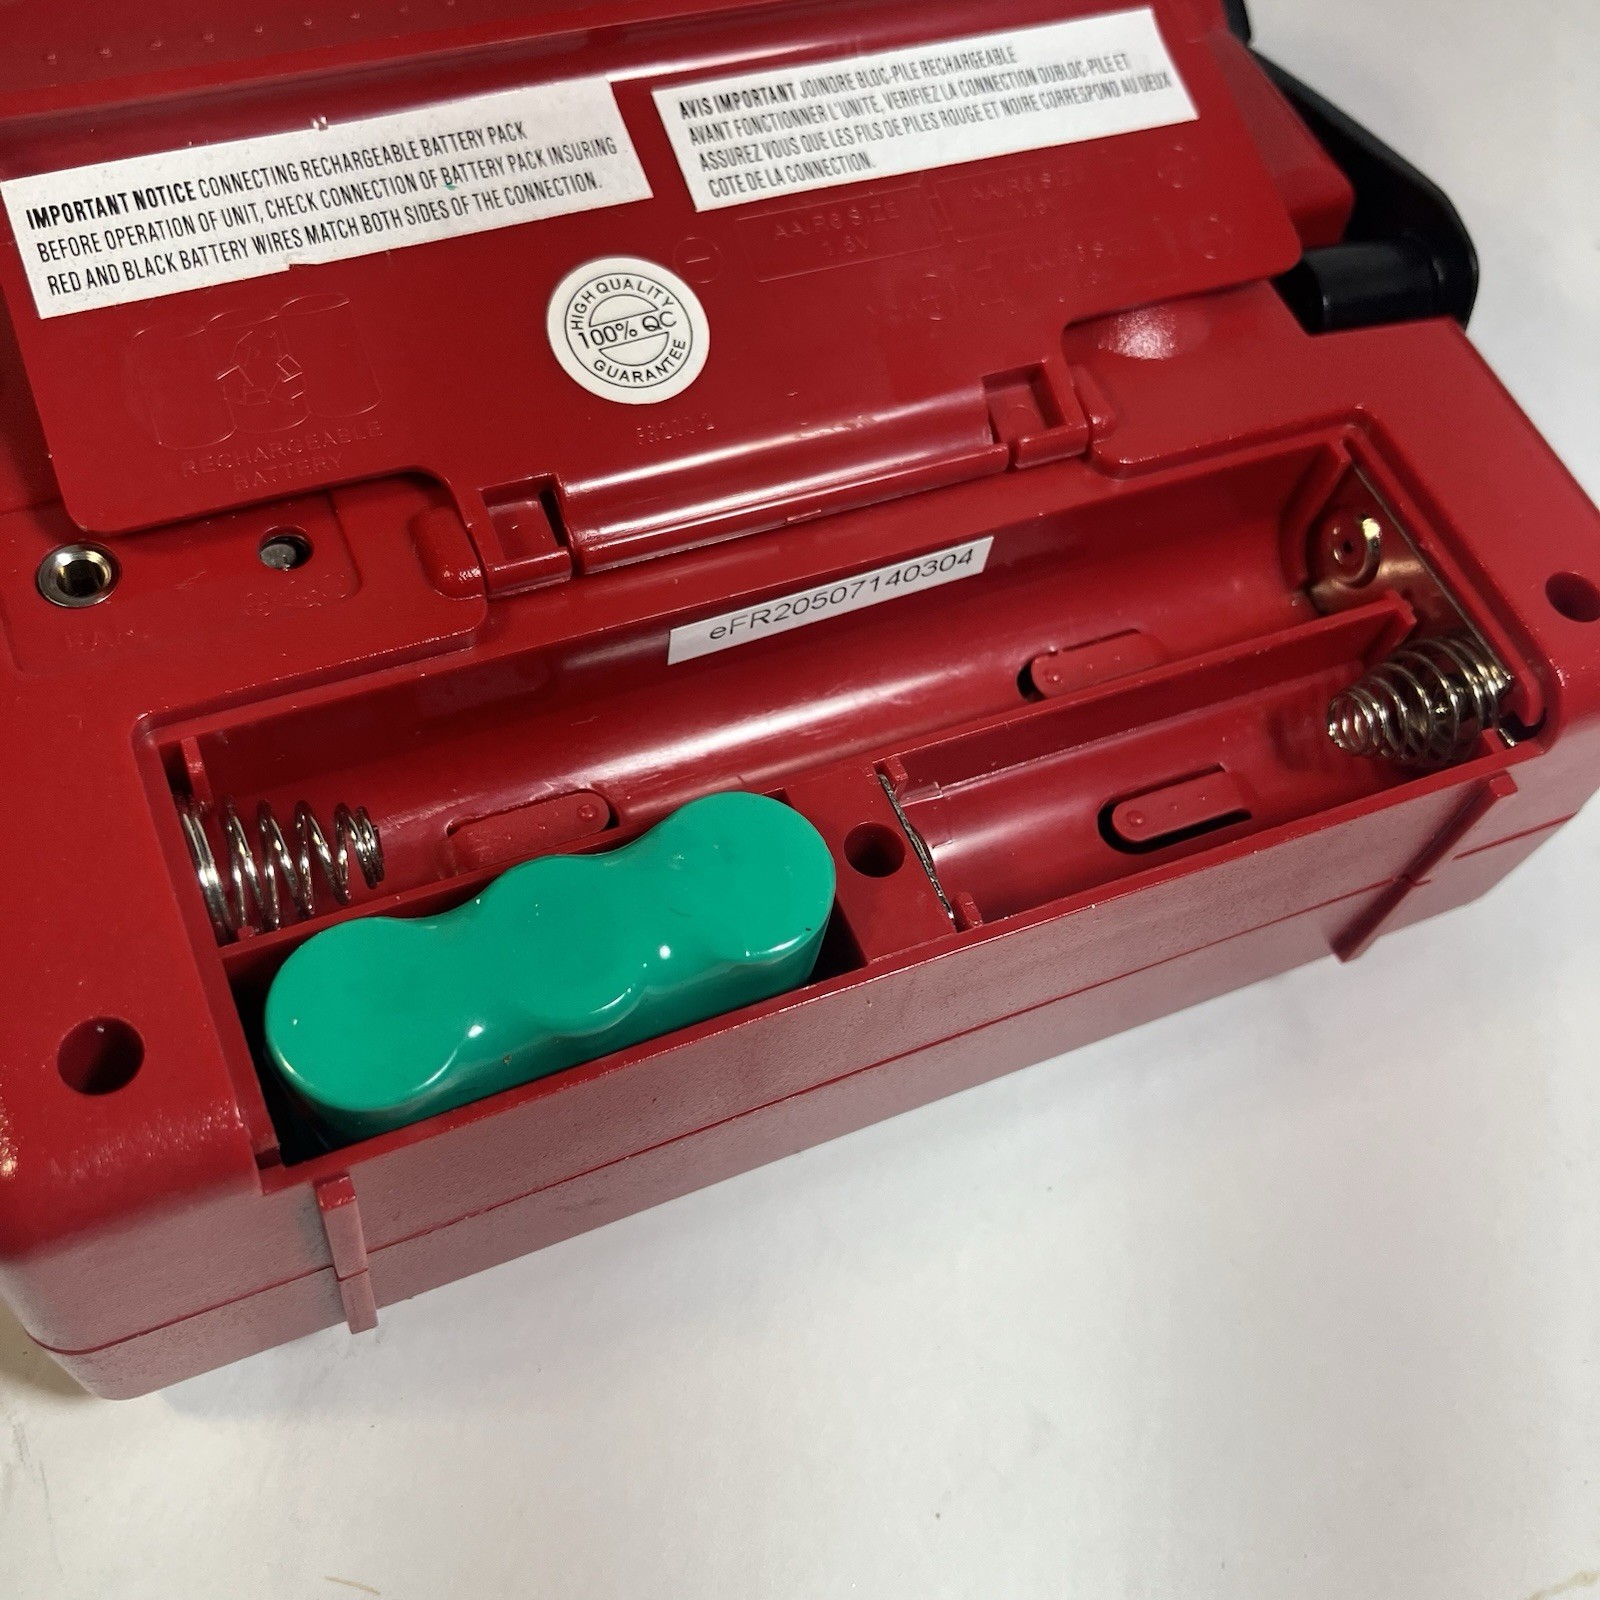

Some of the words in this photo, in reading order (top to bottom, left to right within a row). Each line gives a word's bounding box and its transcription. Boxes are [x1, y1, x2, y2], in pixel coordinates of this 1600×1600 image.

[679, 98, 712, 120] AVIS
[712, 82, 797, 113] IMPORTANT
[800, 72, 855, 99] JOINDRE
[855, 61, 921, 86] BLOC-PILE
[920, 46, 1018, 78] RECHARGEABLE
[689, 120, 736, 146] AVANT
[736, 105, 830, 138] FONCTIONNER
[882, 85, 941, 110] VERIFIEZ
[942, 83, 958, 101] LA
[959, 68, 1039, 99] CONNECTION
[1113, 53, 1131, 73] ET
[699, 144, 763, 173] ASSUREZ
[761, 136, 801, 160] VOUS
[800, 131, 830, 153] QUE
[830, 126, 855, 149] LES
[854, 121, 883, 143] FILS
[882, 118, 903, 138] DE
[902, 111, 941, 135] PILES
[940, 103, 983, 128] ROUGE
[983, 100, 1001, 120] ET
[1000, 95, 1042, 117] NOIRE
[1039, 81, 1122, 110] CORRESPOND
[1121, 77, 1140, 97] AU
[1138, 71, 1173, 94] DEUX
[26, 193, 129, 230] IMPORTANT
[132, 181, 197, 211] NOTICE
[199, 163, 300, 198] CONNECTING
[303, 141, 421, 180] RECHARGEABLE
[420, 128, 484, 158] BATTERY
[487, 120, 528, 147] PACK
[36, 232, 102, 263] BEFORE
[105, 215, 197, 250] OPERATION
[199, 212, 219, 233] OF
[221, 203, 265, 229] UNIT,
[266, 191, 319, 220] CHECK
[321, 173, 418, 209] CONNECTION
[419, 168, 439, 190] OF
[441, 155, 506, 185] BATTERY
[508, 150, 547, 176] PACK
[549, 136, 618, 168] INSURING
[708, 175, 746, 198] COTE
[745, 171, 766, 191] DE
[764, 167, 786, 187] LA
[786, 151, 876, 184] CONNECTION.
[47, 270, 81, 296] RED
[86, 263, 121, 290] AND
[124, 252, 178, 282] BLACK
[179, 238, 249, 271] BATTERY
[251, 228, 303, 256] WIRES
[304, 218, 360, 246] MATCH
[360, 207, 404, 234] BOTH
[404, 200, 450, 226] SIDES
[450, 196, 472, 217] OF
[472, 189, 504, 213] THE
[504, 171, 603, 206] CONNECTION.
[570, 290, 596, 331] HIGH
[595, 278, 675, 307] QUALITY
[577, 319, 638, 349] 100%
[642, 311, 677, 332] QC
[593, 339, 687, 383] GUARANTEE
[709, 548, 974, 641] eFR20507140304
